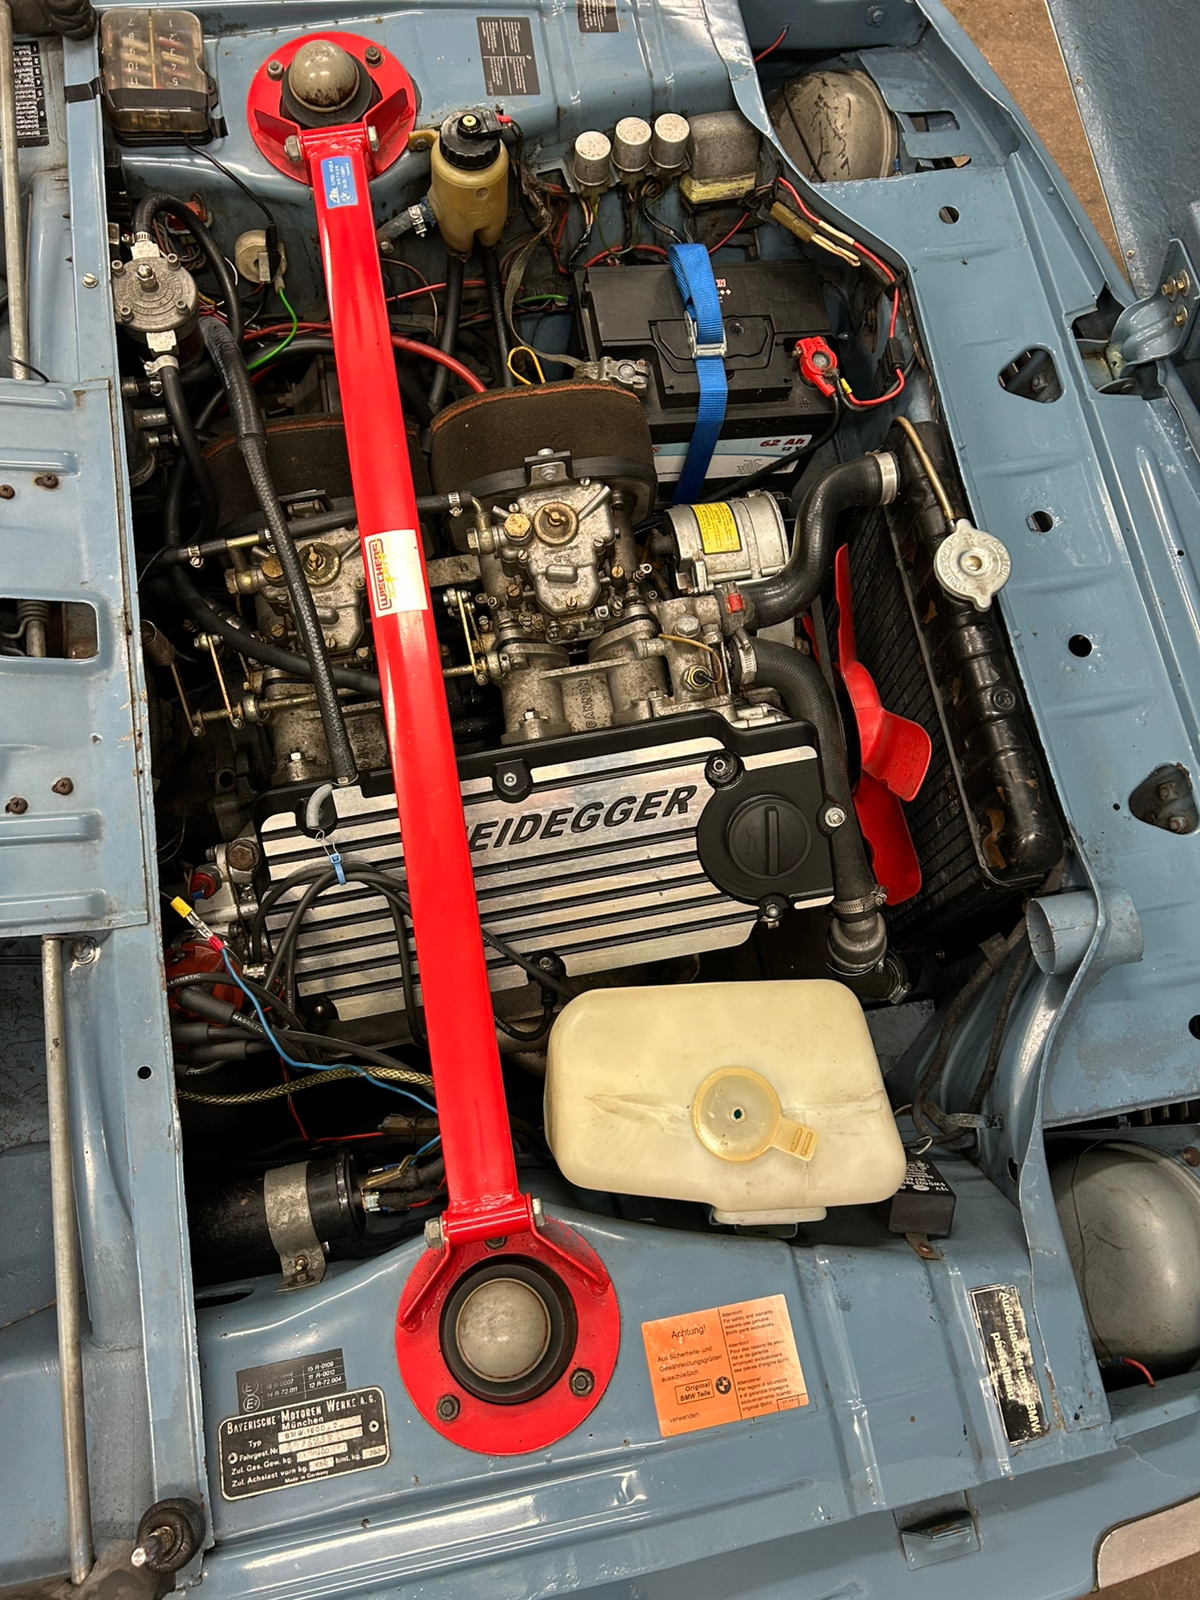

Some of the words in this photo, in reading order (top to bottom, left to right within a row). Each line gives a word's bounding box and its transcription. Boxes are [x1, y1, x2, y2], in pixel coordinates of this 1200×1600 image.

[127, 17, 134, 25] 7
[129, 46, 135, 54] 9
[169, 47, 175, 55] 3
[129, 76, 138, 84] 11
[171, 77, 178, 85] 5
[759, 437, 782, 448] 62
[782, 436, 805, 446] Ah
[580, 677, 597, 729] CANNON
[469, 783, 698, 852] EIDEGGER
[231, 1013, 265, 1033] MAGNETIC
[671, 1325, 706, 1339] Achtung!
[670, 1349, 701, 1360] Sicherheits-
[315, 1361, 334, 1370] R-0109
[990, 1331, 1017, 1401] pastellblau
[316, 1370, 335, 1378] R-0012
[685, 1380, 710, 1392] Original
[680, 1393, 695, 1401] BMW
[696, 1389, 710, 1397] Teile
[227, 1415, 276, 1434] BAYERISCHE
[281, 1405, 321, 1422] MOTOREN
[327, 1397, 356, 1413] WERKE
[669, 1411, 700, 1423] verwenden.
[282, 1416, 323, 1430] München
[249, 1438, 261, 1448] Typ
[246, 1462, 262, 1472] Ges.
[264, 1458, 281, 1468] Gew.
[283, 1455, 293, 1465] kg.
[247, 1471, 277, 1484] Achslast
[280, 1467, 296, 1476] vorn
